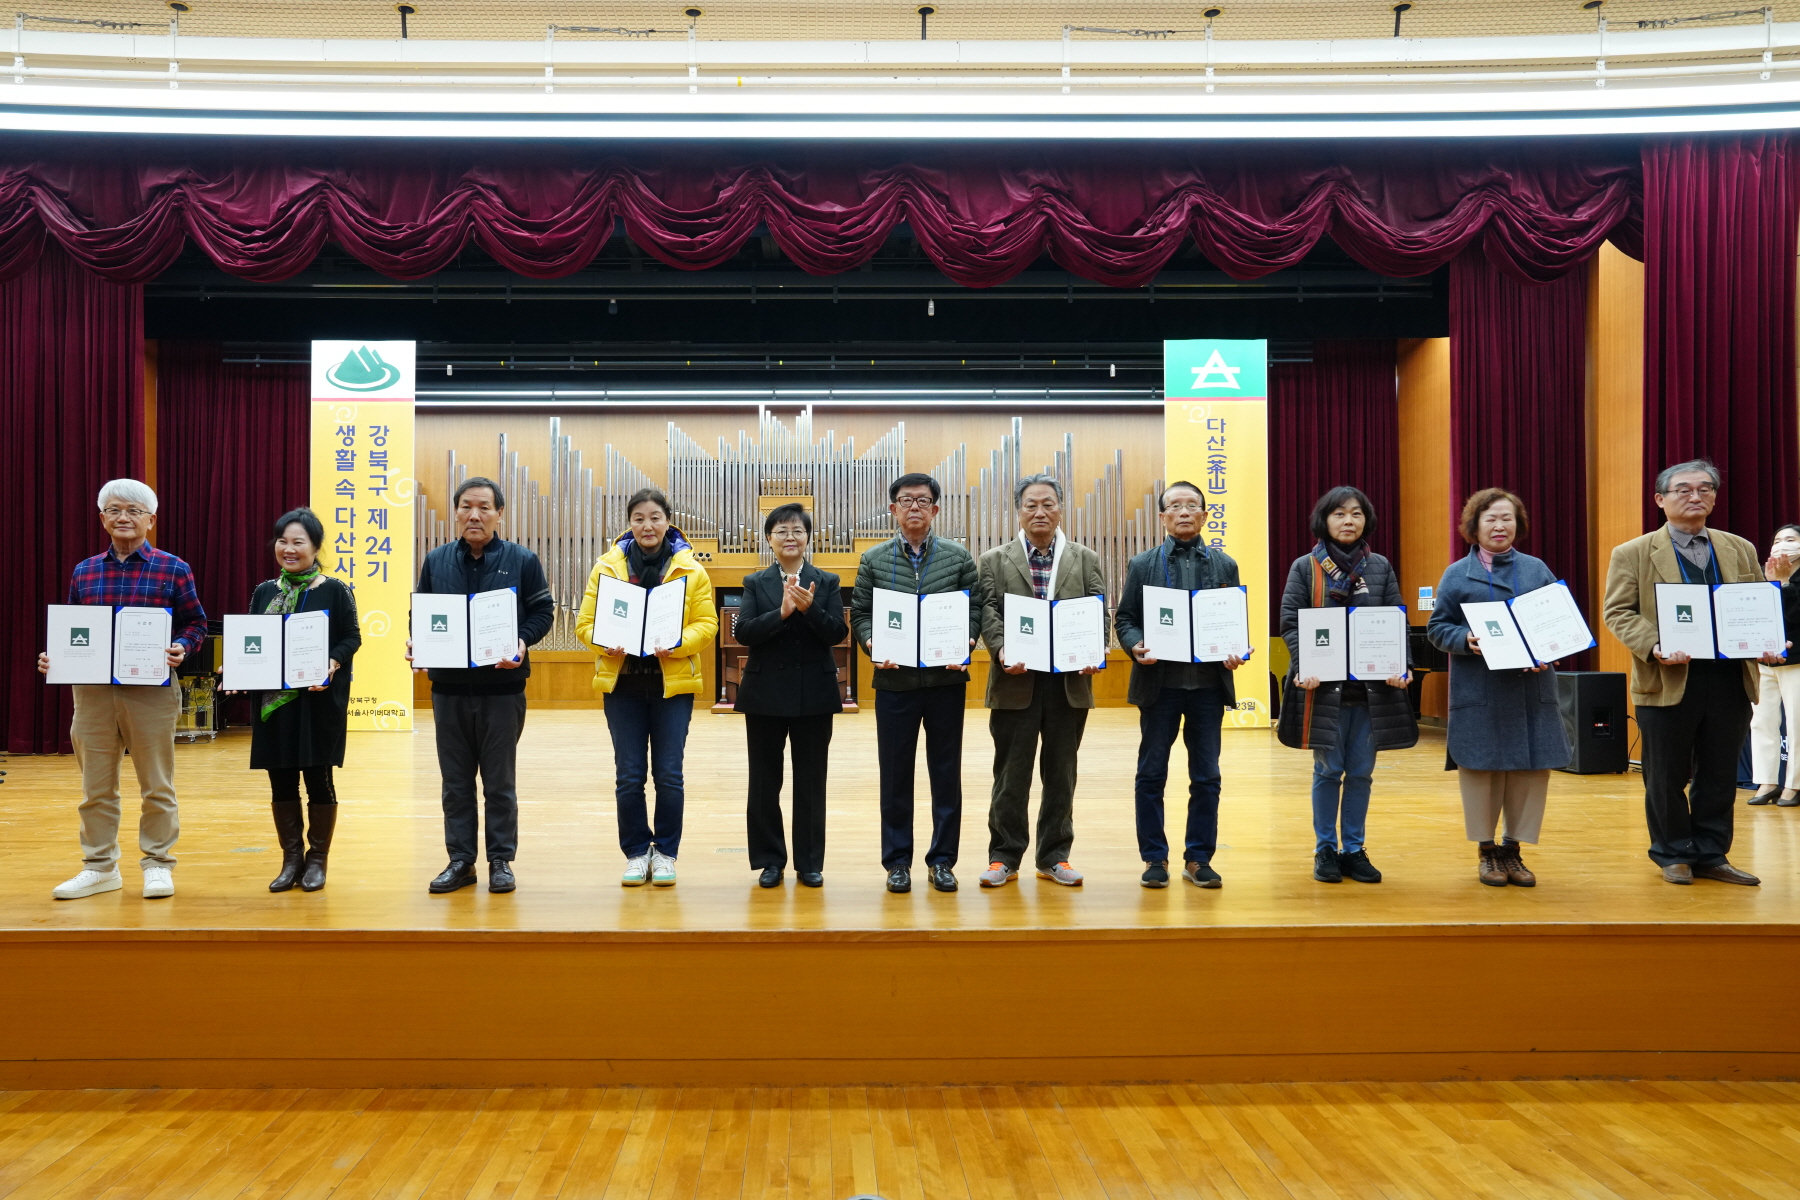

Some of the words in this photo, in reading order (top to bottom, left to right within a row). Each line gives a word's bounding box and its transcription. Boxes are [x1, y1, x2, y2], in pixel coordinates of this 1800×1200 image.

[335, 425, 357, 472] 생활
[368, 425, 390, 496] 강북구
[335, 478, 356, 500] 속
[365, 508, 392, 582] 제24기
[1207, 503, 1228, 552] 정약용
[346, 709, 406, 717] 서울사이버대학교
